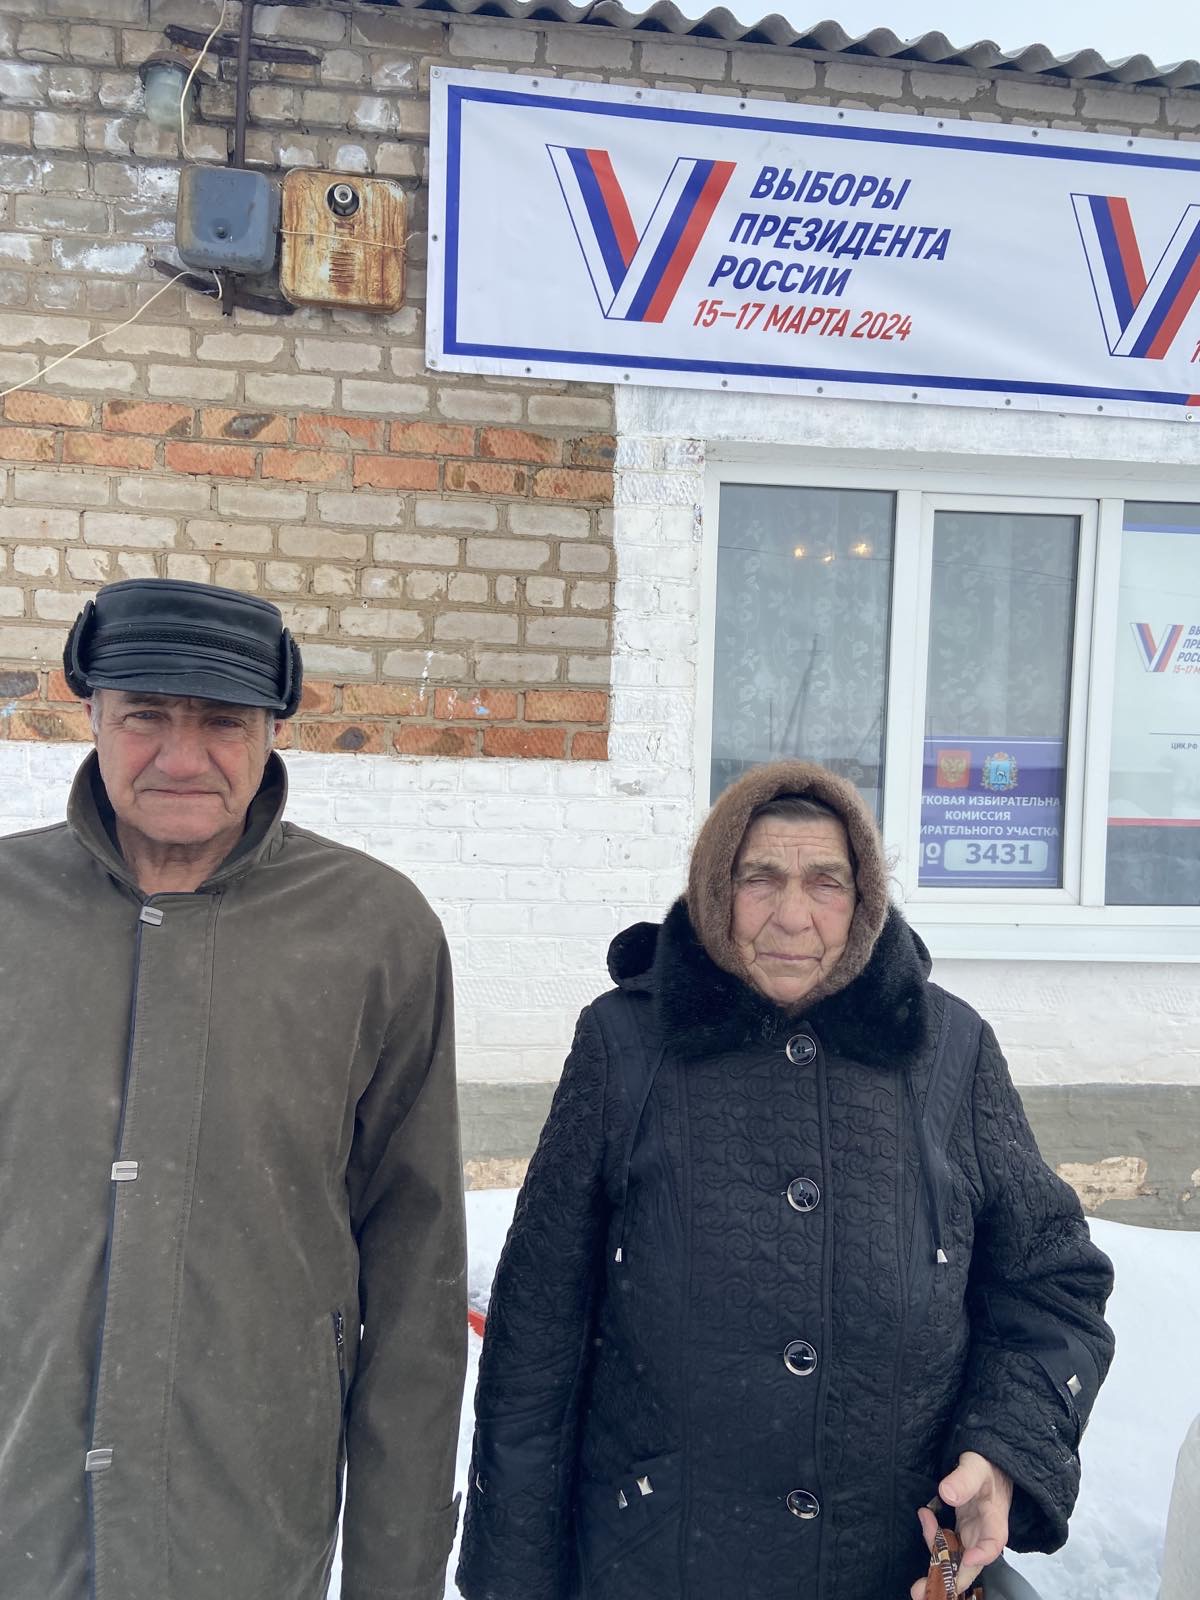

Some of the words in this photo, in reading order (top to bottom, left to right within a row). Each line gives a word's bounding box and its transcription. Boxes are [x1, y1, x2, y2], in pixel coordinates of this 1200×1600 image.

[750, 165, 911, 210] ВЫБОРЫ
[729, 213, 952, 261] ПРЕЗИДЕНТА
[708, 254, 853, 297] РОССИИ
[763, 304, 851, 337] МАРТА
[850, 310, 913, 341] 2024
[945, 810, 1011, 821] КОМИССИЯ
[1006, 826, 1059, 836] УЧАСТКА
[966, 843, 1032, 865] 3431
